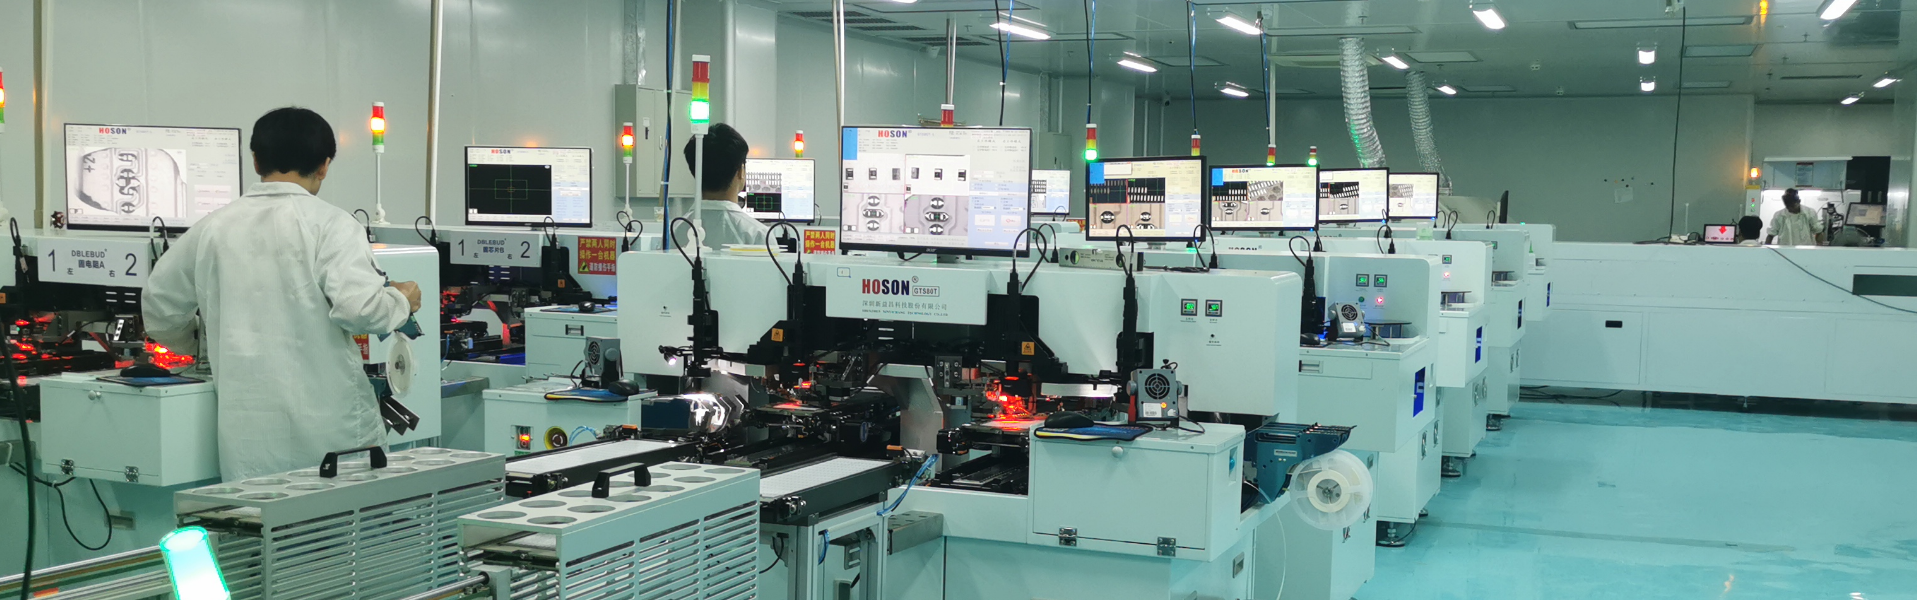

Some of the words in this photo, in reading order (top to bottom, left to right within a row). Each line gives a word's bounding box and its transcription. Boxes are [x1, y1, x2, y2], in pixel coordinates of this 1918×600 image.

[805, 231, 835, 239] 严禁两人同时
[458, 239, 464, 256] 1
[520, 240, 531, 259] 2
[579, 238, 616, 249] 严禁两人同时
[805, 240, 835, 249] 操作一台机器
[71, 249, 106, 258] DBLEBUD
[579, 249, 616, 261] 操作一台机器
[48, 249, 55, 272] 1
[125, 253, 137, 276] 2
[862, 279, 910, 296] HOSON
[914, 287, 938, 296] GTS80T
